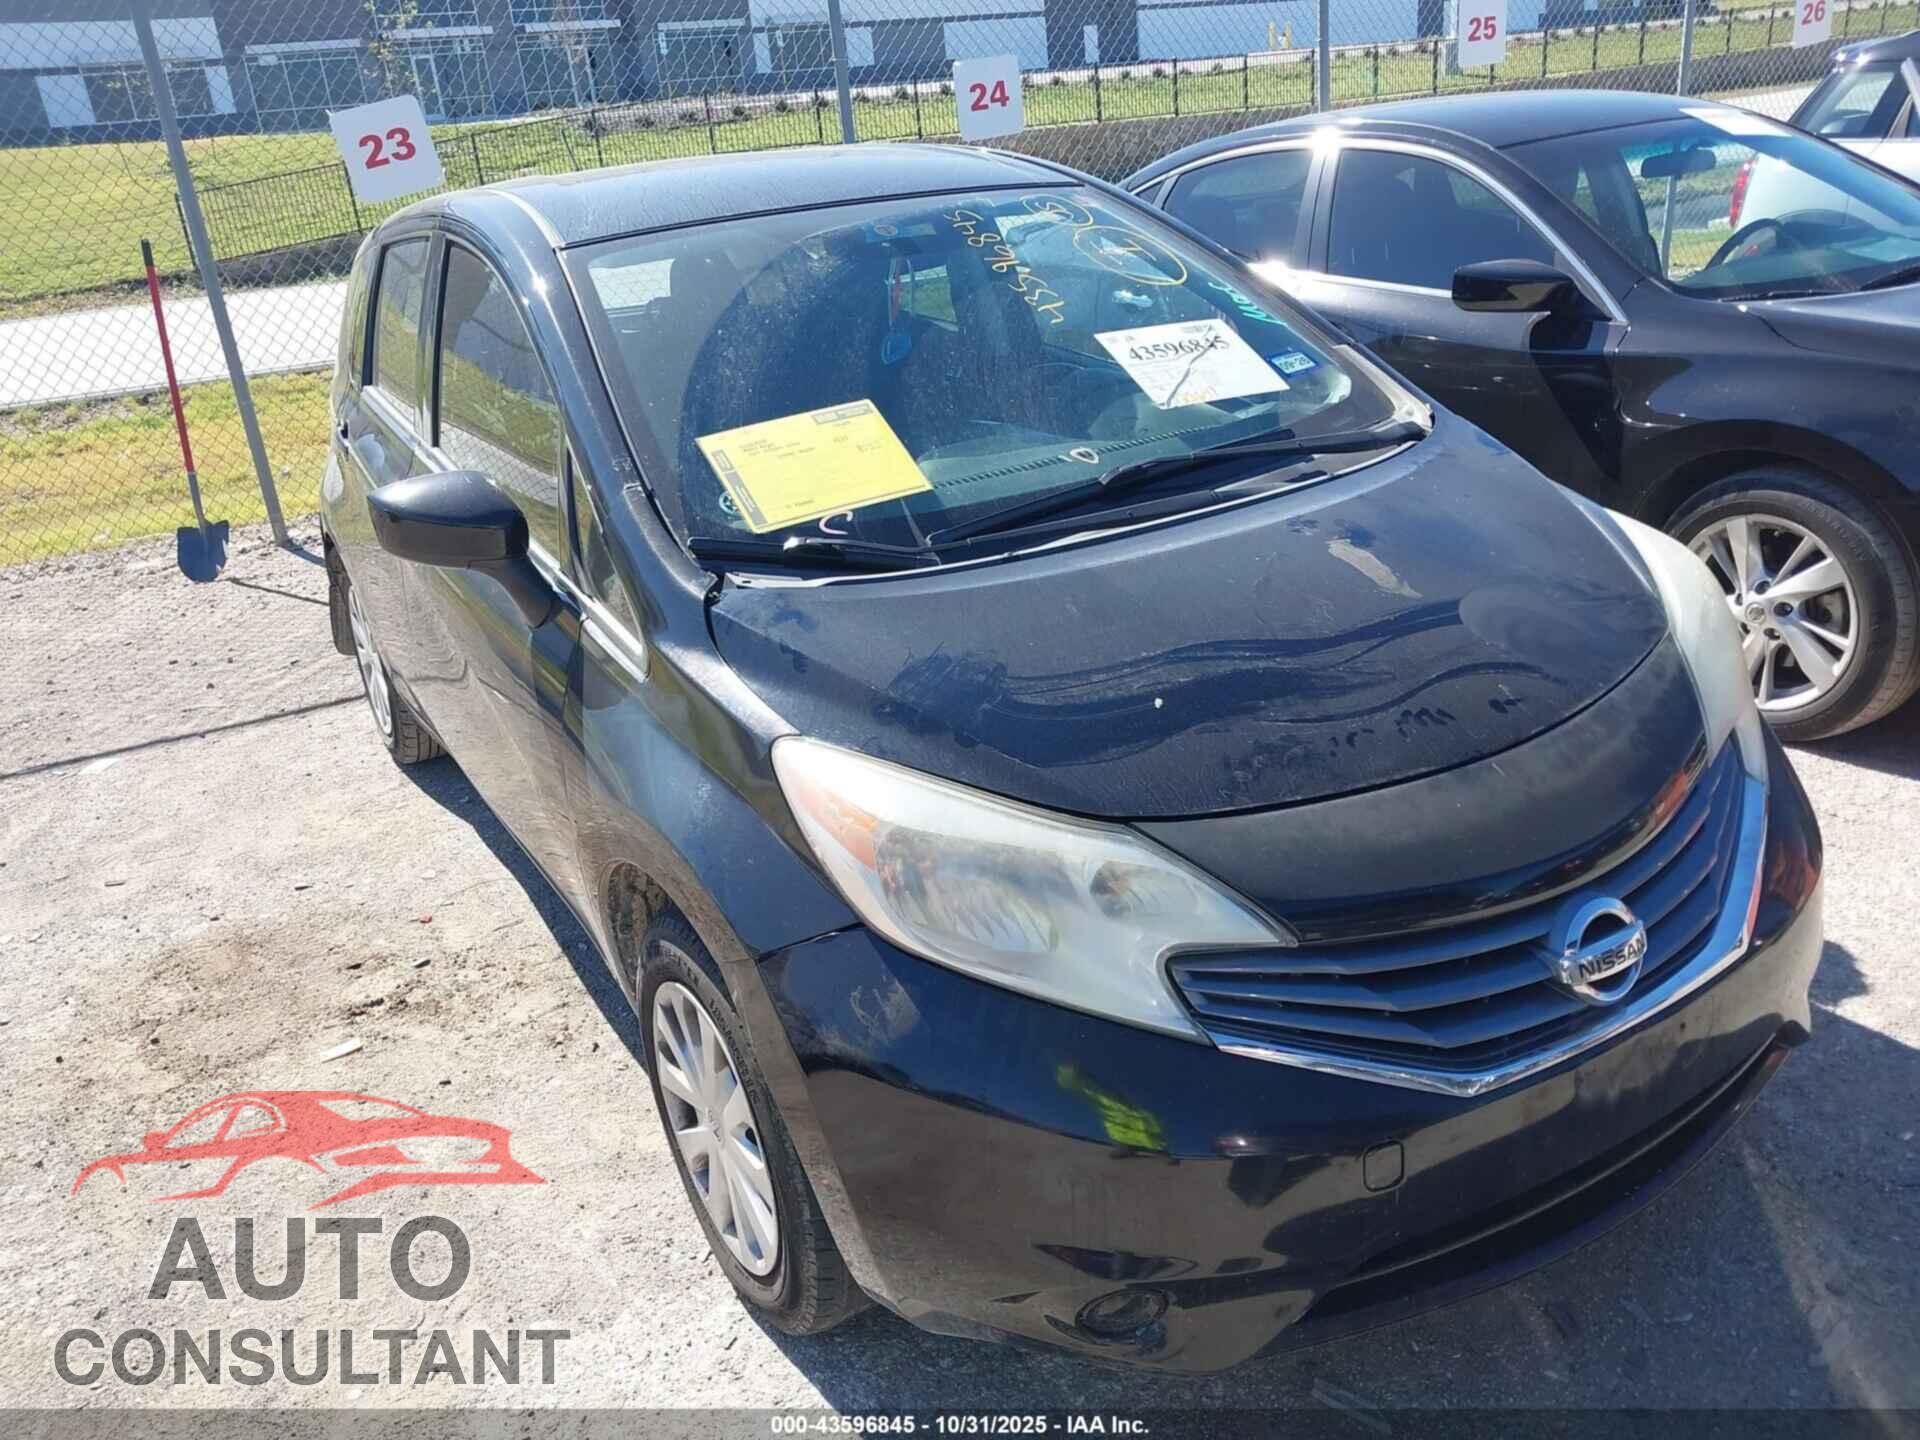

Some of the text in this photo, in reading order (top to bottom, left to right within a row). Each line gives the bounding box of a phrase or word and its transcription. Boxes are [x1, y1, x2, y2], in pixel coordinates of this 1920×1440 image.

[1801, 0, 1826, 26] 26
[1468, 15, 1497, 42] 25
[969, 79, 1010, 112] 24
[358, 127, 416, 169] 23
[1128, 334, 1231, 362] 43596845
[1578, 938, 1646, 979] NISSAN
